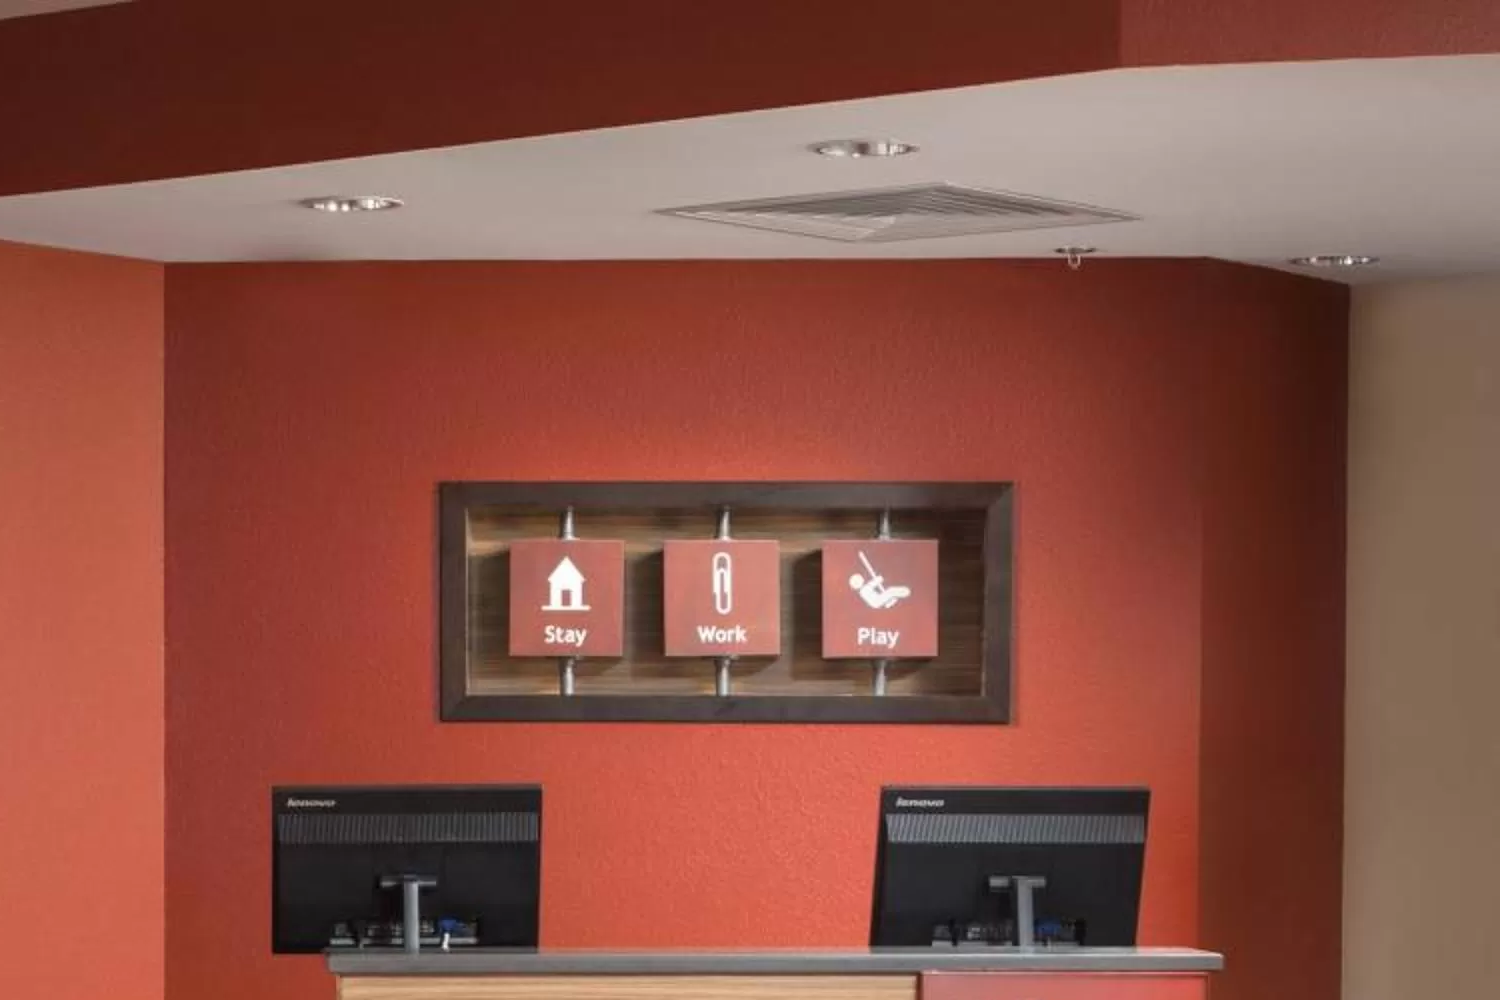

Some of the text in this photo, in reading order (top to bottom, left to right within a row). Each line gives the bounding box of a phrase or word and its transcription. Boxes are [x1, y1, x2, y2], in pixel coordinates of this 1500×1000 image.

[544, 625, 587, 645] Stay
[697, 625, 748, 644] Work
[857, 627, 900, 648] Play
